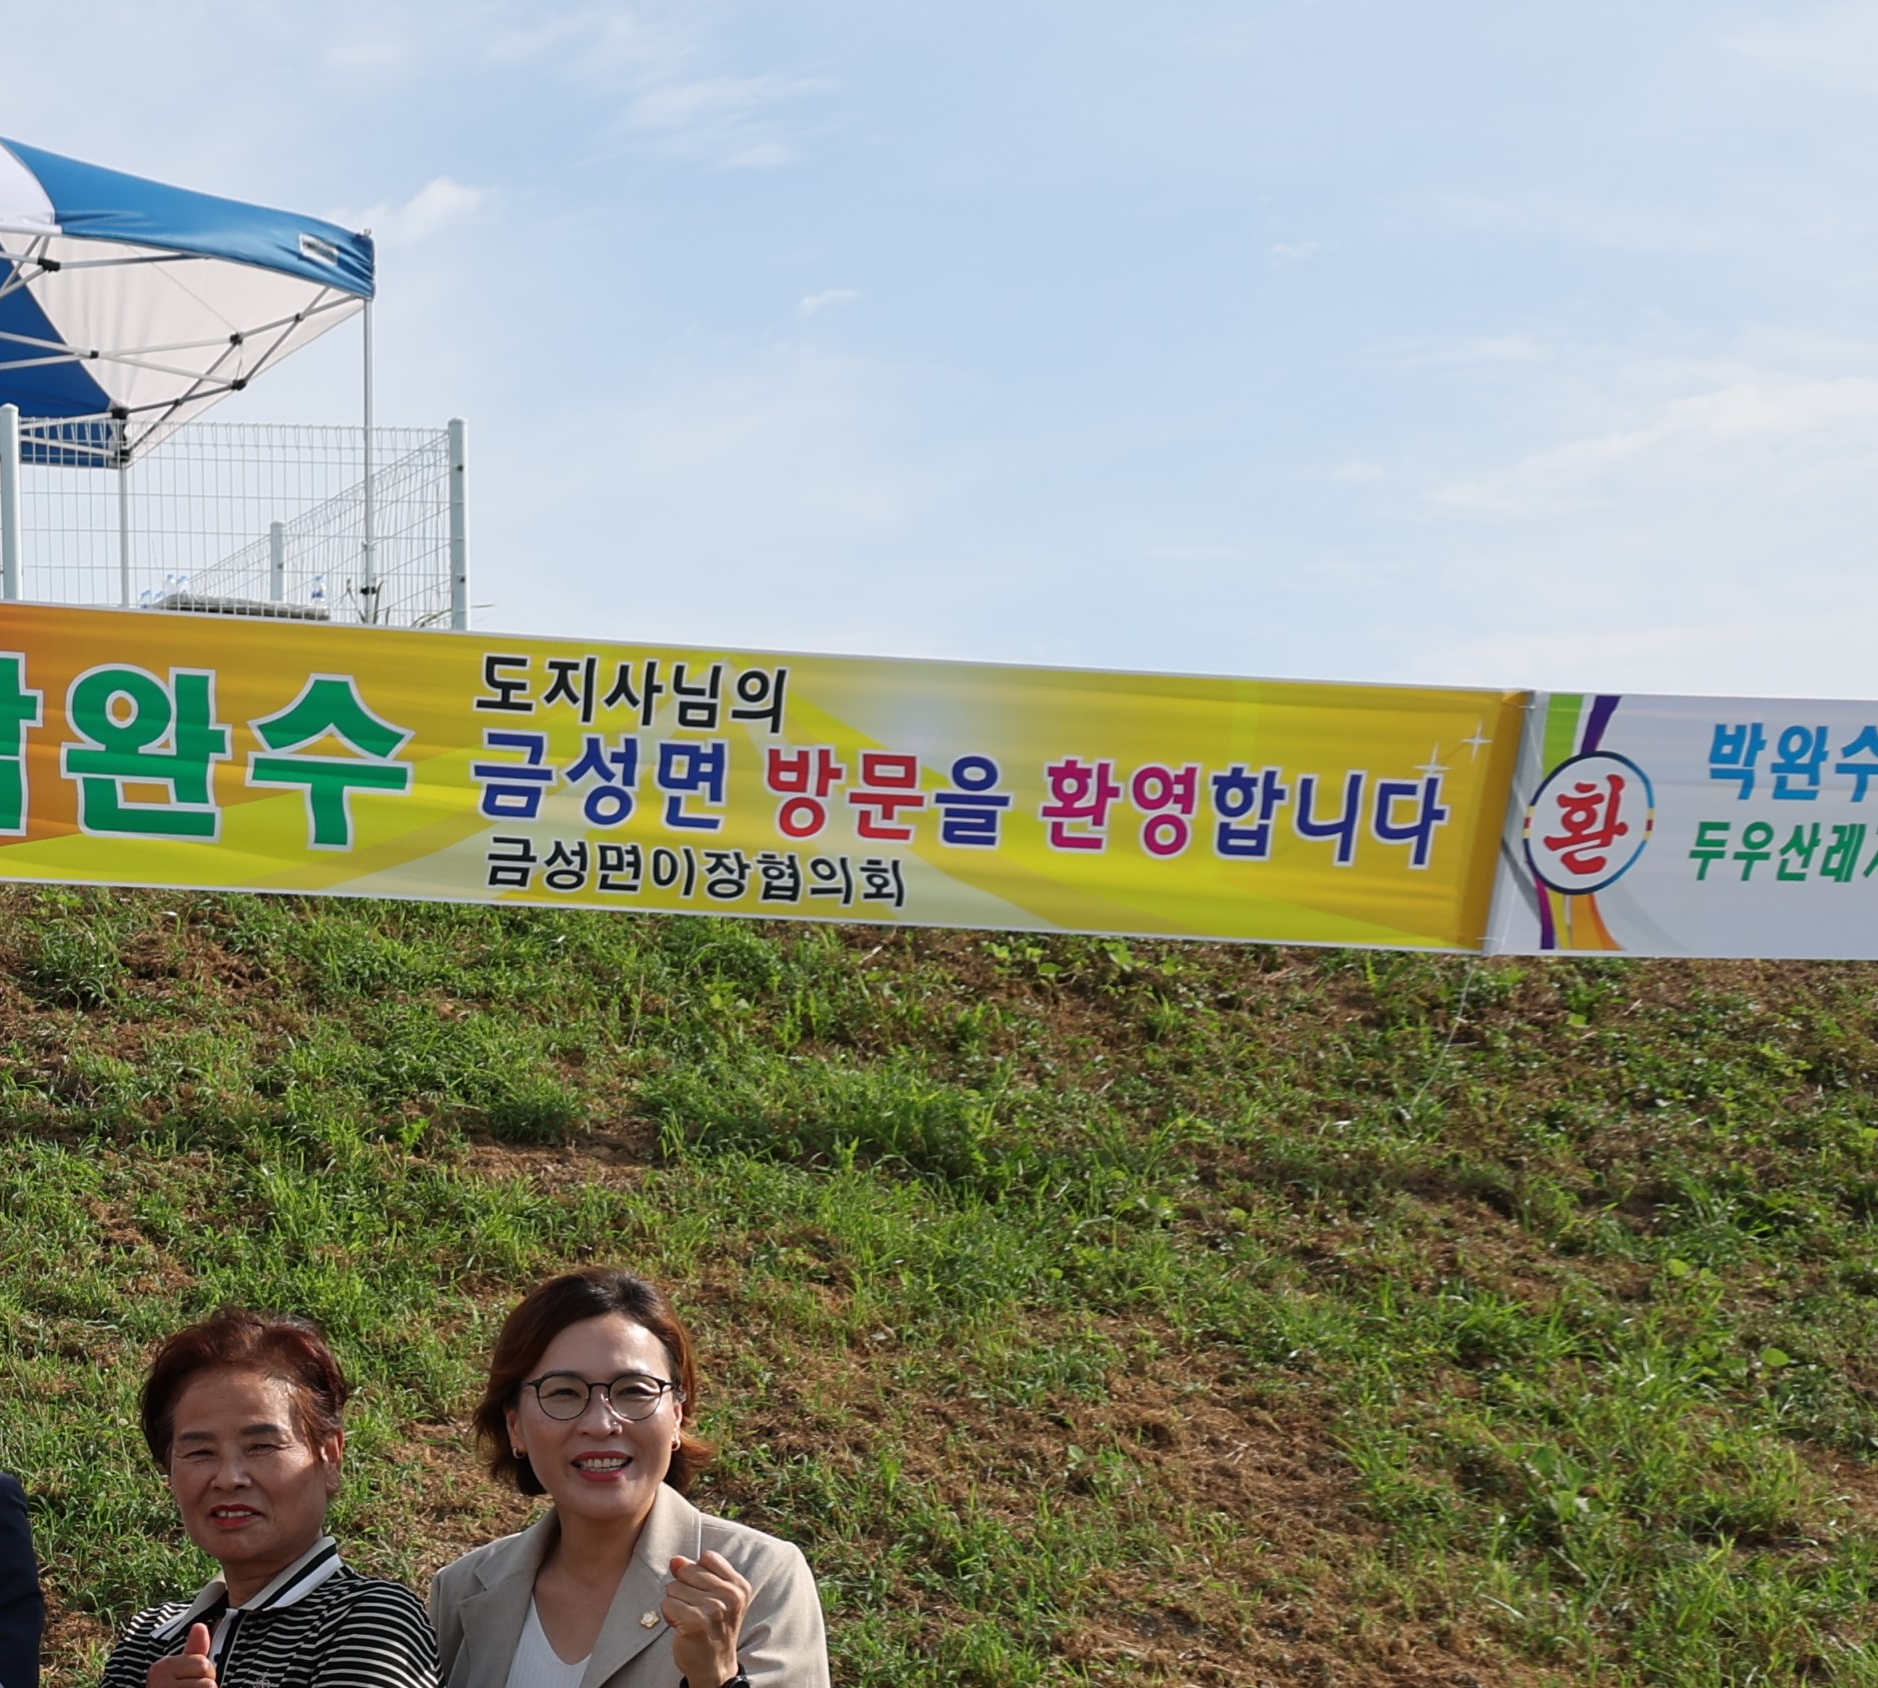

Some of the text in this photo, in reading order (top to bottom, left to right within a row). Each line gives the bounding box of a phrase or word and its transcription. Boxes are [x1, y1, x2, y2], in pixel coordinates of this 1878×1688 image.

[474, 653, 790, 734] 도지사님의
[472, 729, 1448, 869] 금성면 방문을 환영합니다
[1543, 774, 1629, 875] 환
[486, 836, 906, 907] 금성면이장협의회
[1688, 821, 1878, 883] 두우산레
